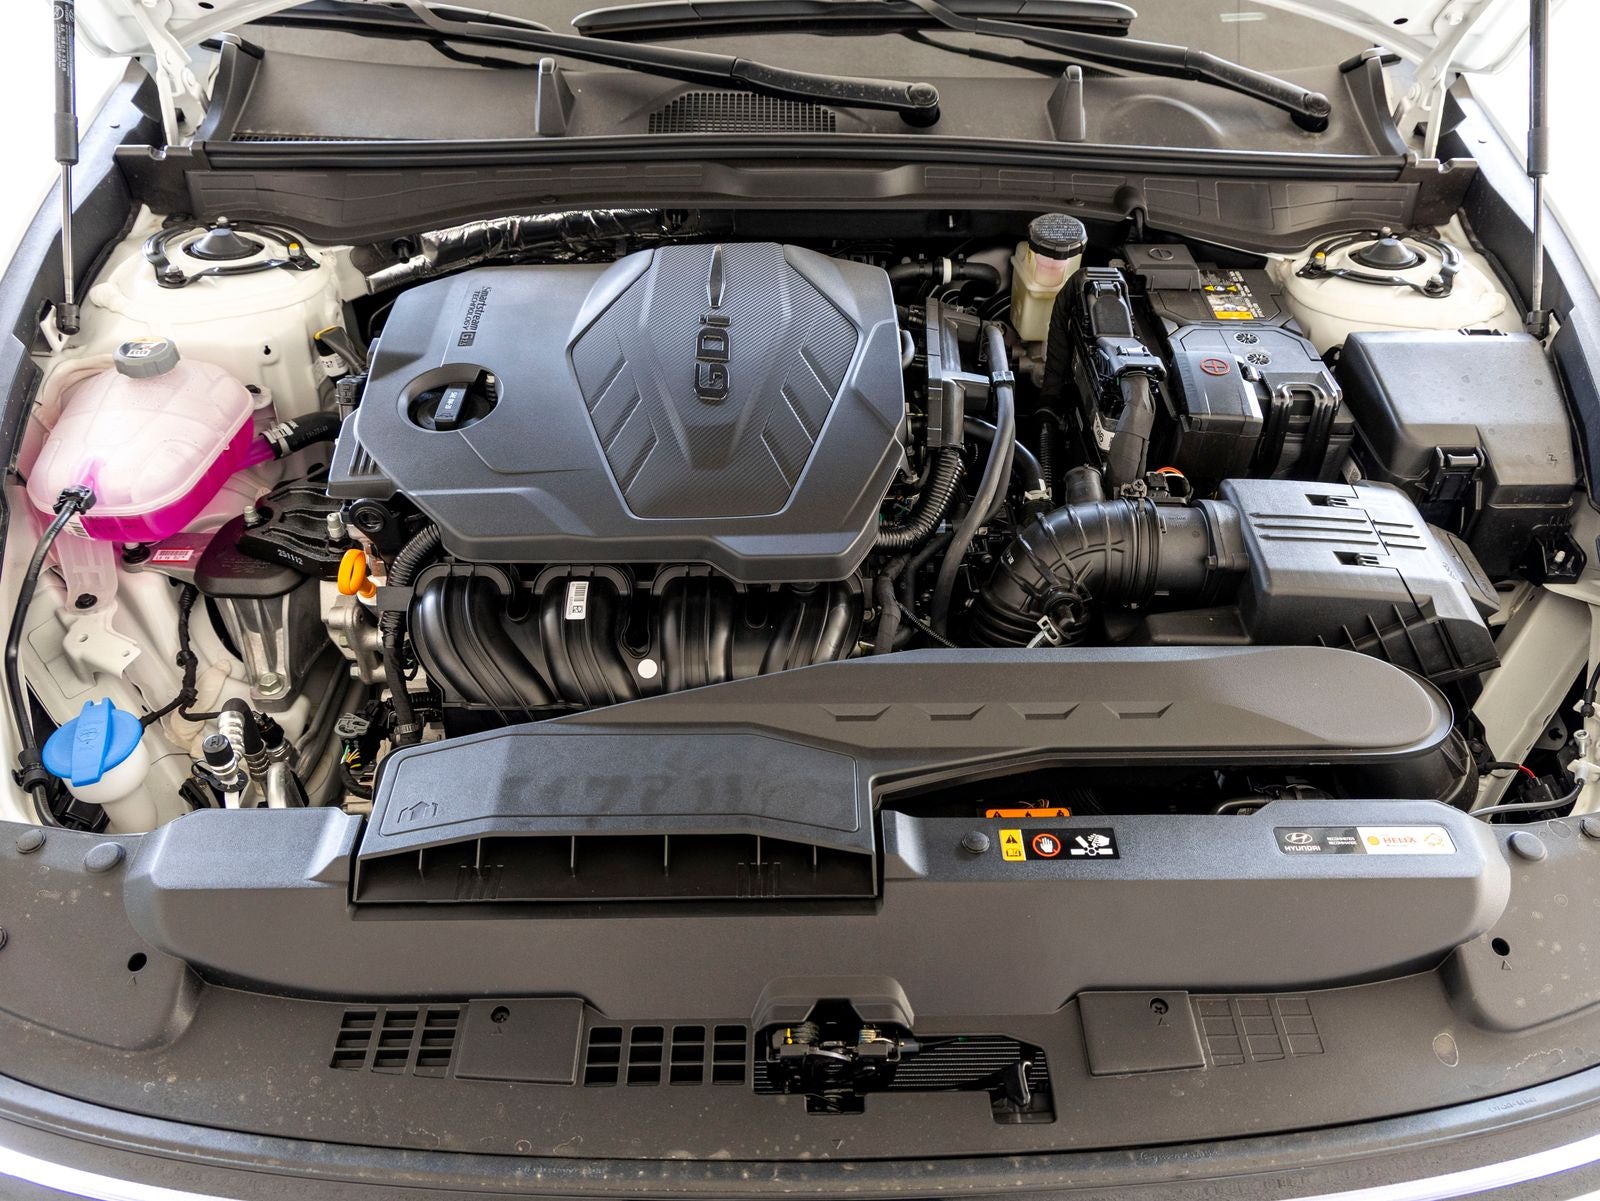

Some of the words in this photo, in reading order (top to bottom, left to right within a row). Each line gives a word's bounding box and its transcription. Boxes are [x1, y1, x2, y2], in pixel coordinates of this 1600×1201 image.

[463, 290, 480, 330] TECHNOLOGY
[469, 286, 492, 331] Smartstream
[1284, 844, 1321, 852] HYUNDAI
